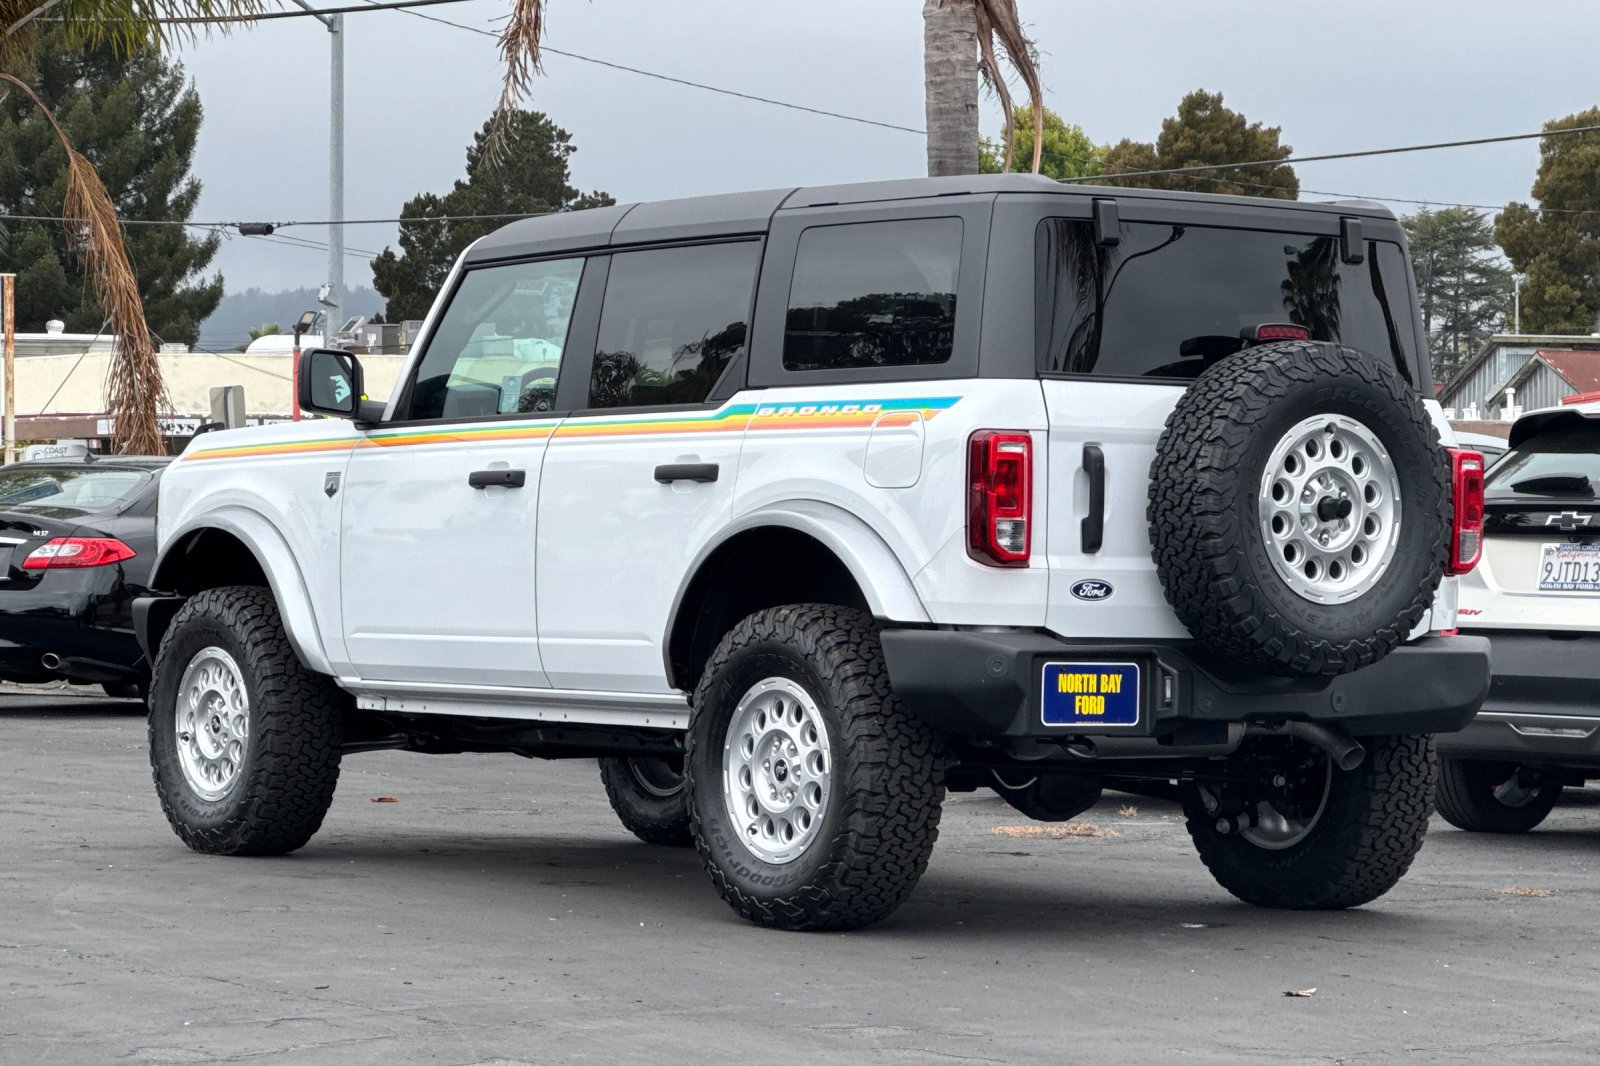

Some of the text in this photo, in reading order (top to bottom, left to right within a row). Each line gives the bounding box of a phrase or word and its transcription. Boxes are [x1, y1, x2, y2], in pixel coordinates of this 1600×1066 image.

[758, 404, 882, 417] BRONCO
[1543, 562, 1600, 583] 9JTD13
[1079, 582, 1107, 597] Ford
[1058, 673, 1123, 693] NORTH BAY
[1075, 695, 1105, 715] FORD
